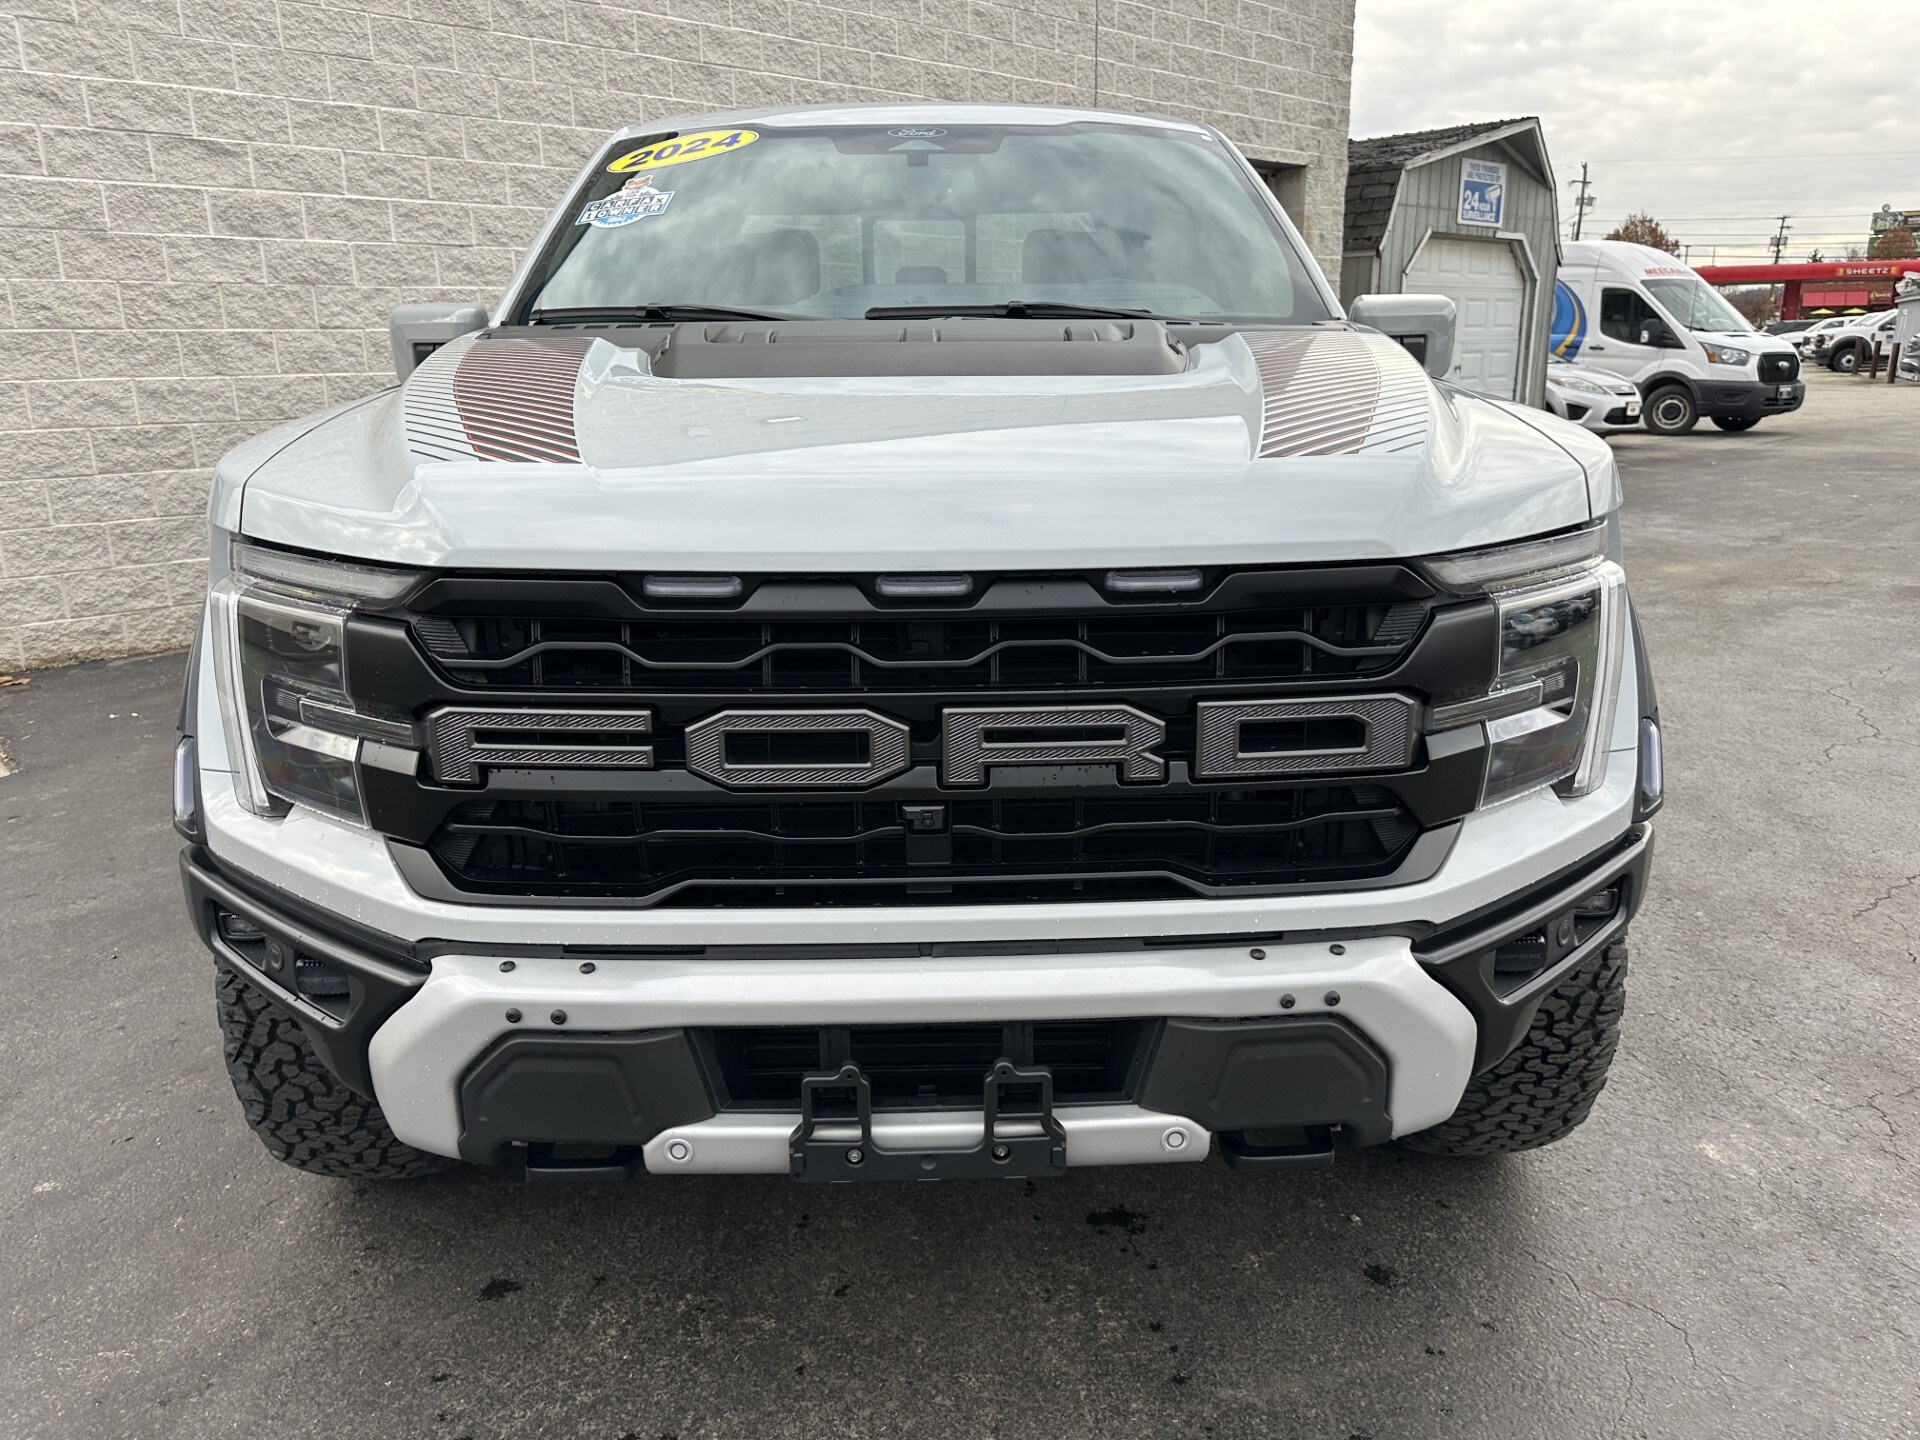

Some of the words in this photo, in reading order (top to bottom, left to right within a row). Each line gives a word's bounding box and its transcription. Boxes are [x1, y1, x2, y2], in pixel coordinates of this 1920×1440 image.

[898, 127, 936, 136] Ford
[622, 133, 743, 169] 2024
[590, 198, 665, 211] CARFAX
[1463, 190, 1479, 211] 24
[1479, 202, 1491, 212] HOUR
[597, 204, 660, 218] OWNER
[1463, 210, 1496, 221] SURVEILLANCE
[1845, 267, 1889, 275] SHEETZ
[428, 693, 1418, 787] FORD
